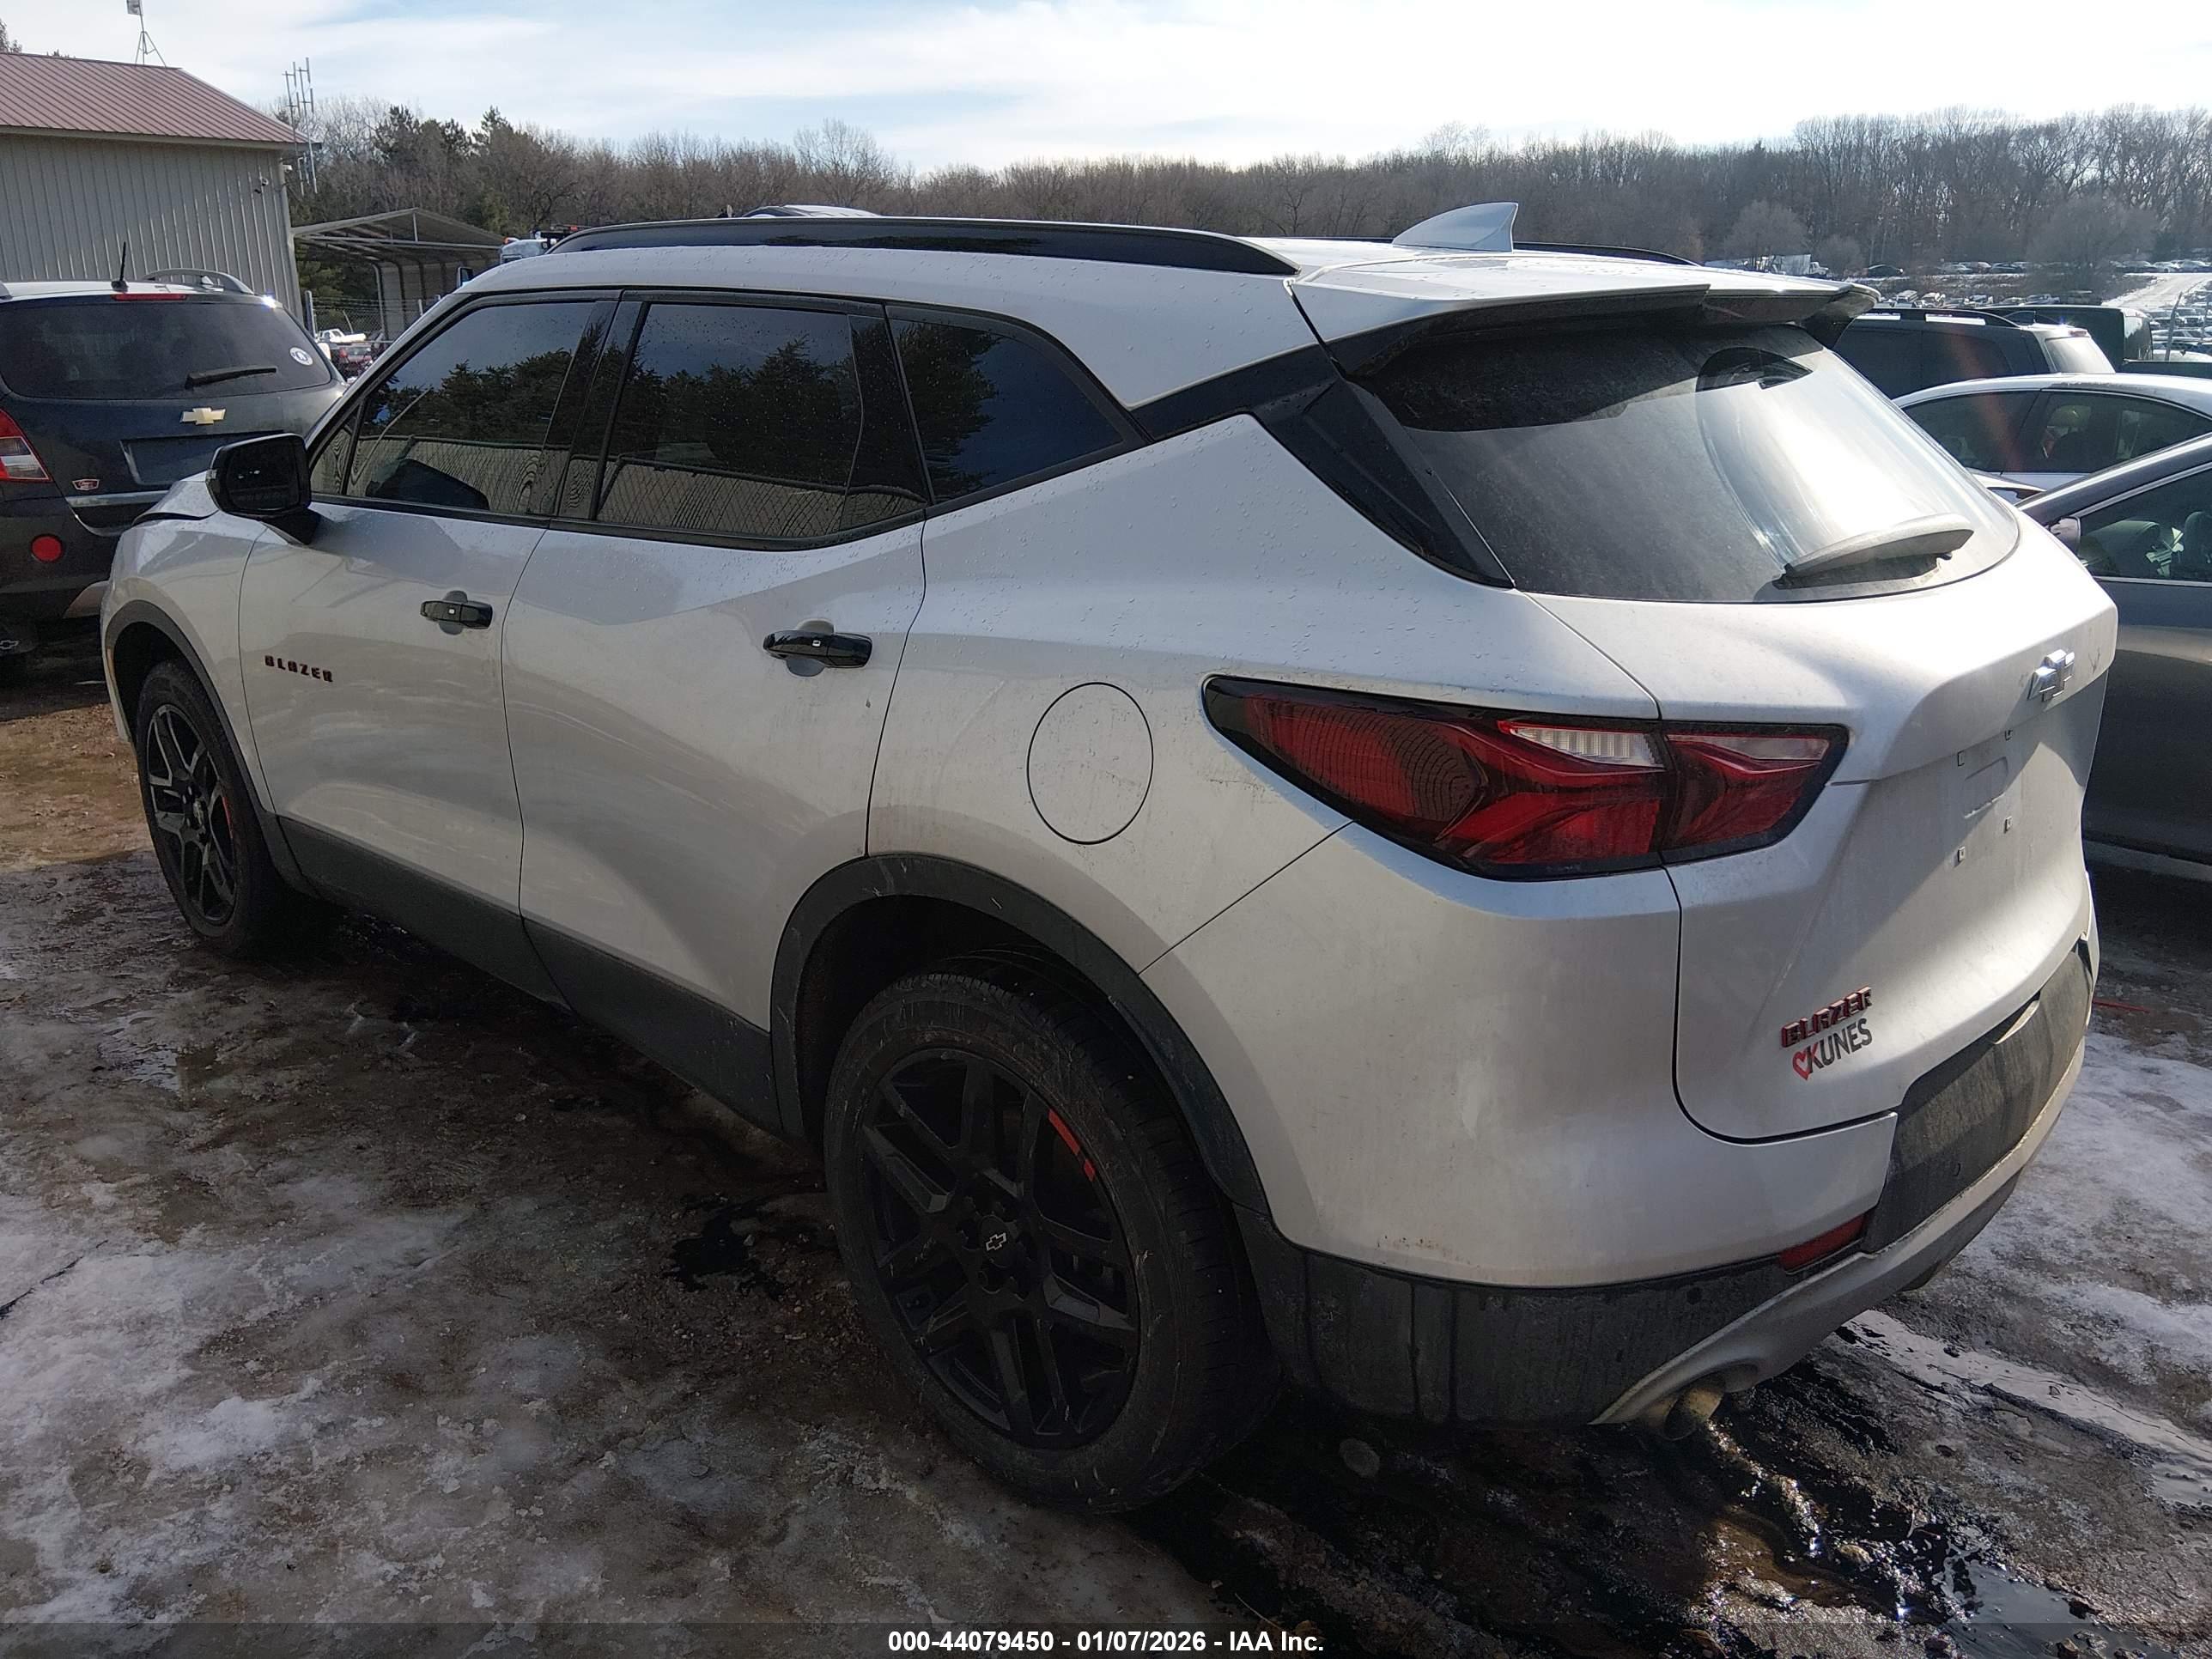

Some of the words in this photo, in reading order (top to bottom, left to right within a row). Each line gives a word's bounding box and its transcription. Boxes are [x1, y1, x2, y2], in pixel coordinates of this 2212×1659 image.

[264, 655, 333, 683] BLAZER
[1781, 985, 1873, 1048] BLAZER
[1804, 1018, 1873, 1074] KUNES
